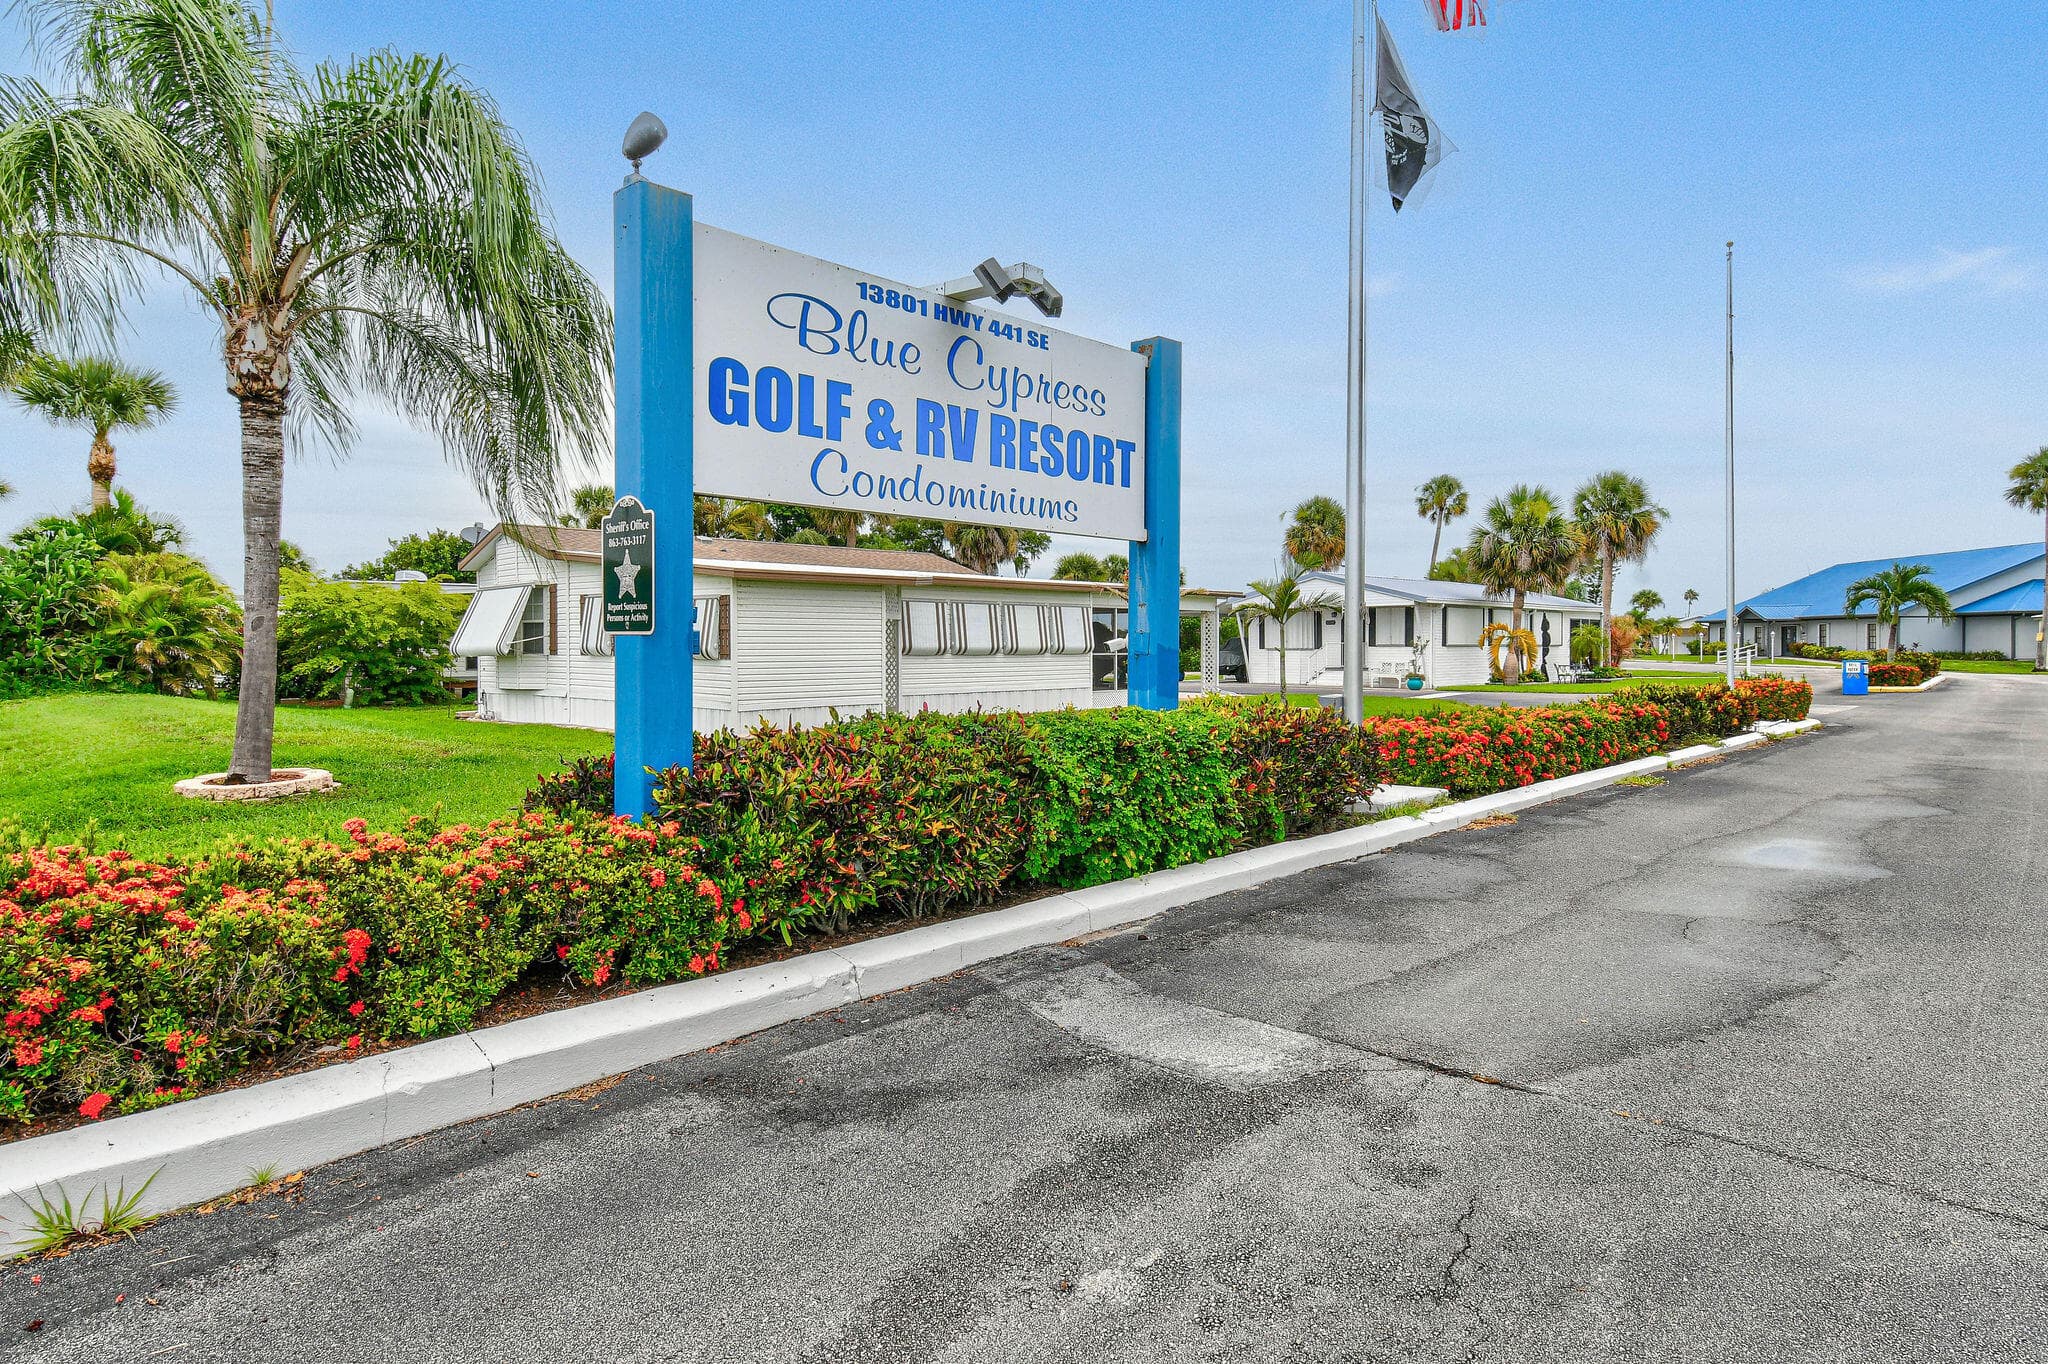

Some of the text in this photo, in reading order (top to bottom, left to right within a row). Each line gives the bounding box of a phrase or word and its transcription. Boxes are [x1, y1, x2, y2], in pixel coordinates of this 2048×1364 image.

[856, 282, 1050, 352] 13801 HWY 441 SE
[767, 293, 1107, 417] Blue Cypress
[708, 356, 1137, 489] GOLF & RV RESORT
[810, 448, 1079, 523] Condominiums
[606, 519, 649, 534] Sheriff's Office
[608, 535, 646, 547] 863-763-3117
[606, 613, 624, 622] Persons
[630, 612, 649, 624] Activity
[608, 601, 648, 613] Report Suspicious
